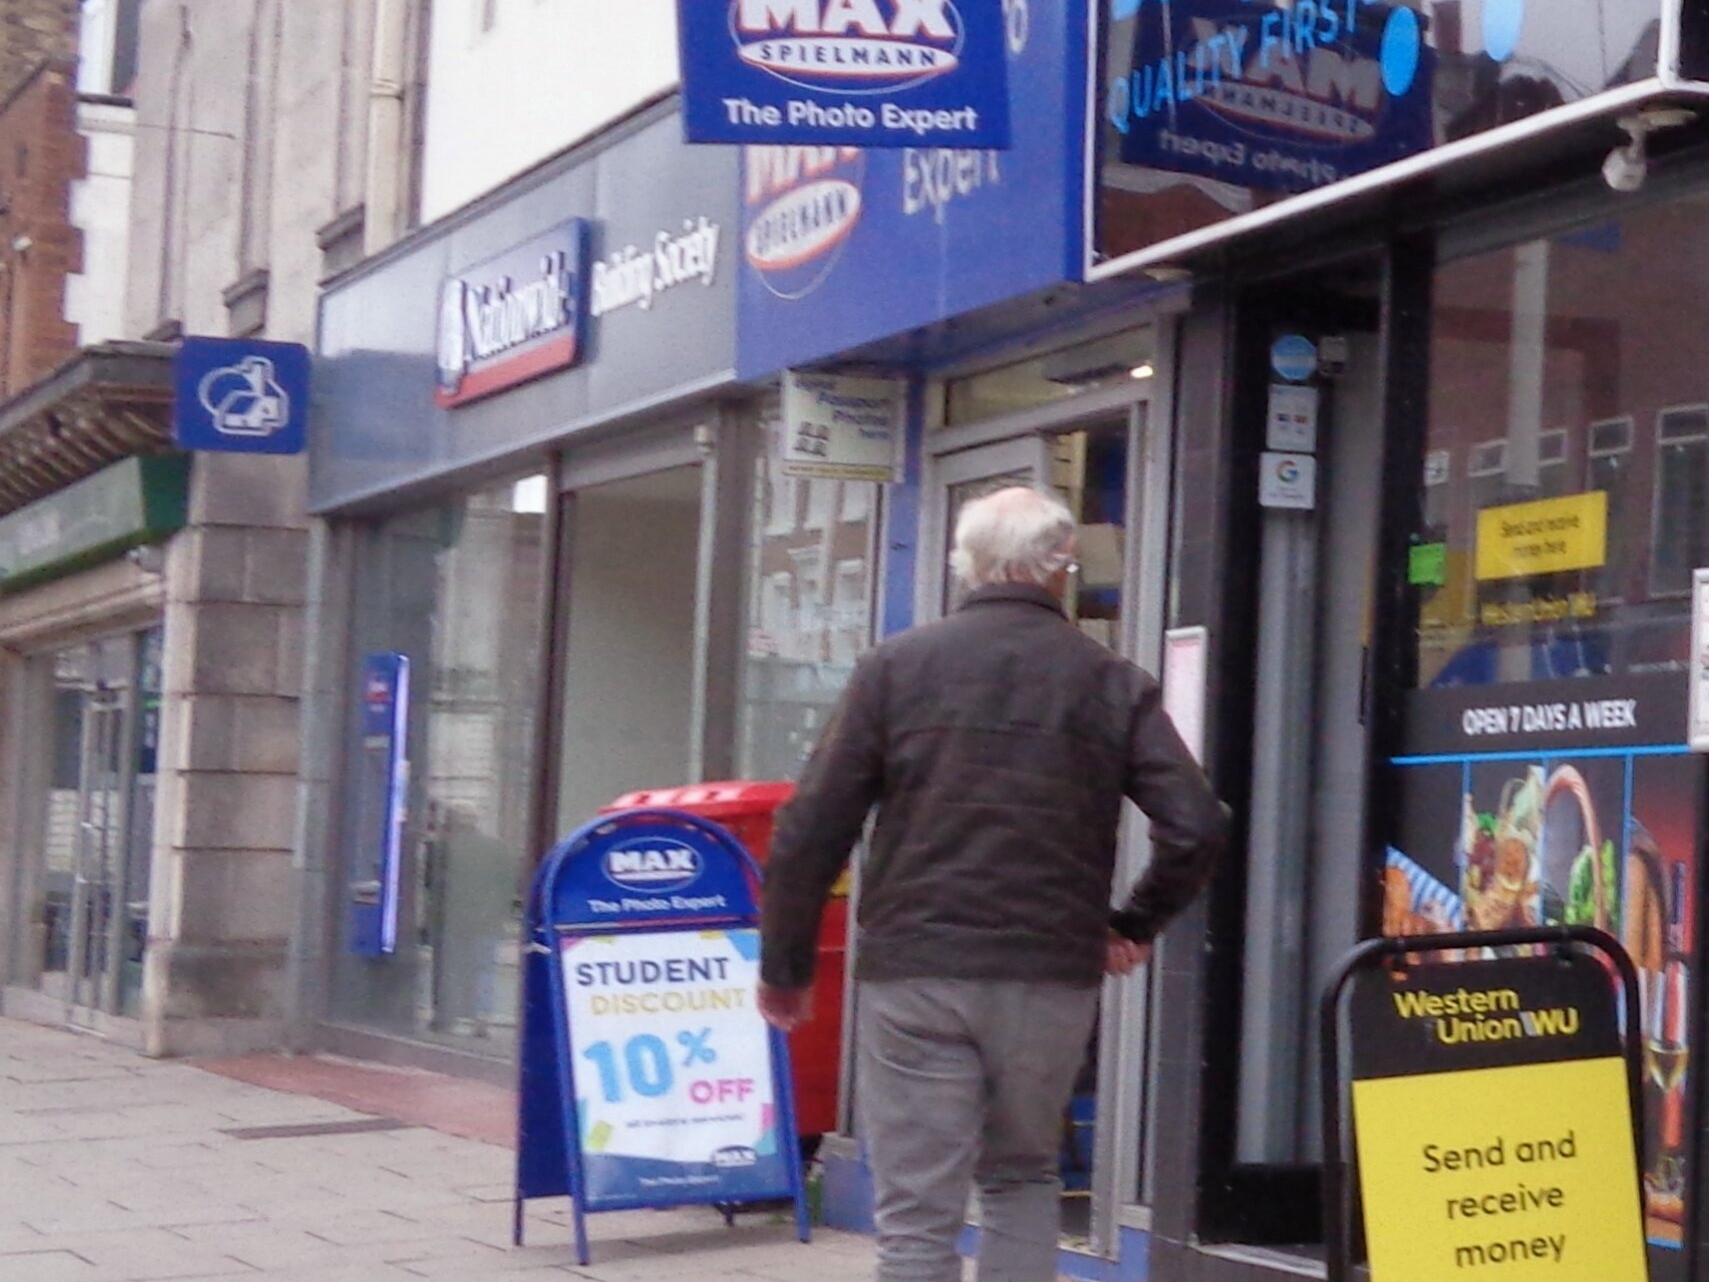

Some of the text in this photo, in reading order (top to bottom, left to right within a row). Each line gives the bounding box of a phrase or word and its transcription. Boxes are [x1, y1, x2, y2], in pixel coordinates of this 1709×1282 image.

[759, 43, 938, 66] SPIELMANN
[1106, 24, 1249, 136] QUALITY
[722, 98, 979, 136] The Photo Expert
[654, 215, 721, 293] Society
[1461, 698, 1638, 735] OPEN 7 DAYS A WEEK
[607, 848, 693, 875] MAX
[587, 894, 728, 914] The Photo Expert
[575, 956, 730, 987] STUDENT
[590, 987, 748, 1018] DISCOUNT
[1393, 987, 1520, 1019] Western
[1436, 1015, 1522, 1046] Union
[688, 1076, 756, 1105] OFF
[1422, 1129, 1578, 1175] Send and
[1445, 1181, 1566, 1221] receive
[1454, 1232, 1567, 1269] money
